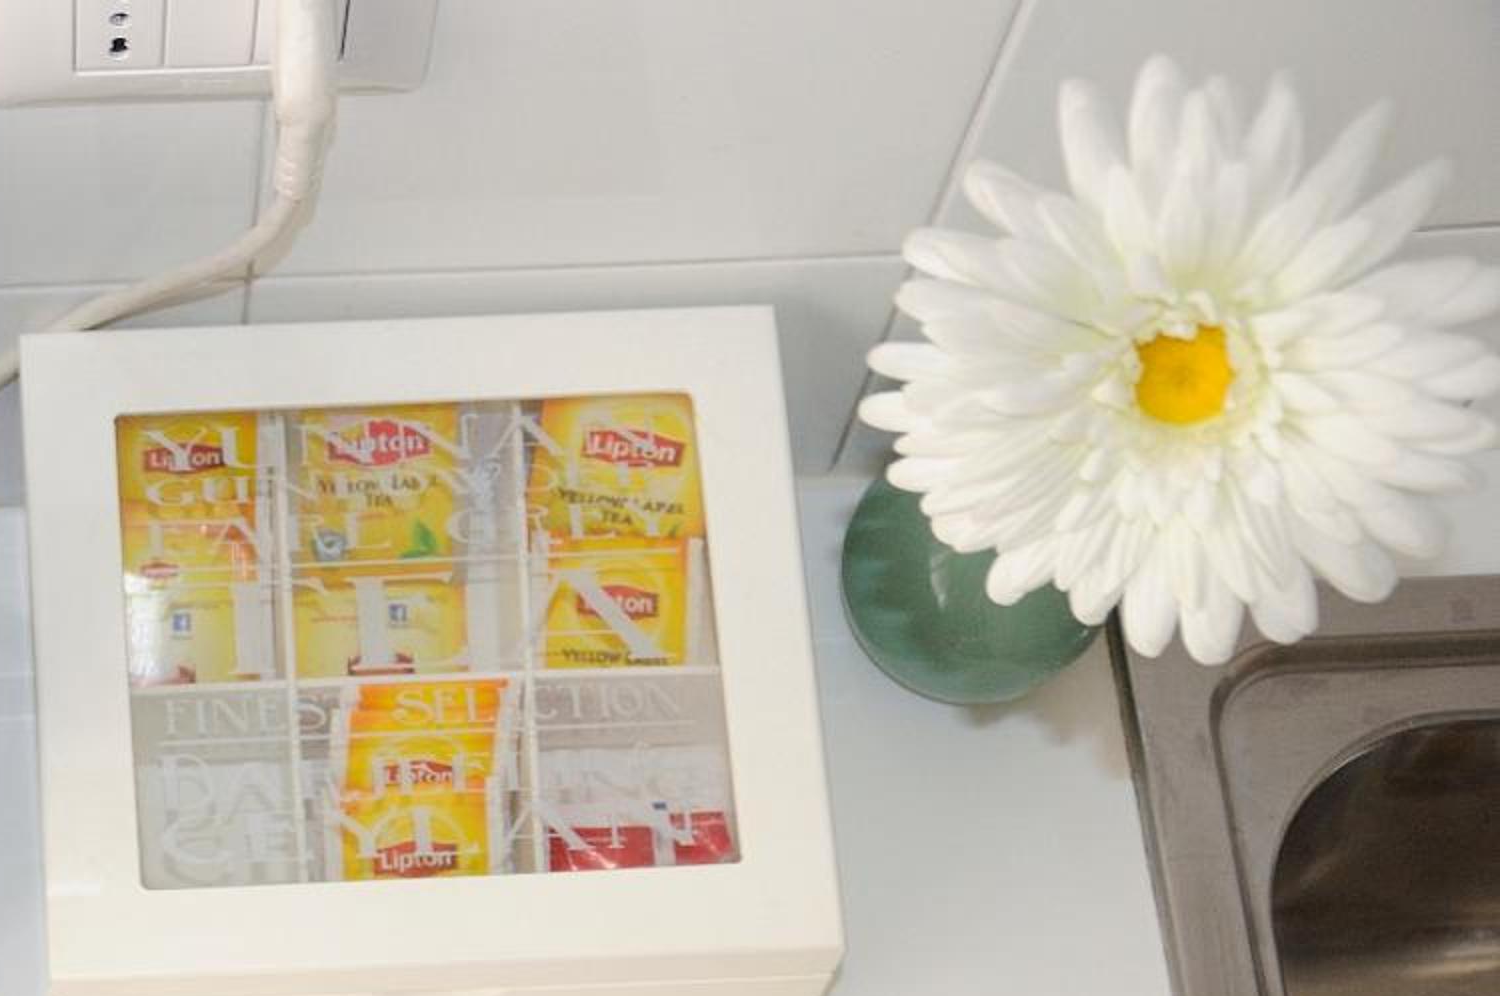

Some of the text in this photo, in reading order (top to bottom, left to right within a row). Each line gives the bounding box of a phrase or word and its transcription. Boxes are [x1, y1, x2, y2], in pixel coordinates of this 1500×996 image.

[150, 449, 221, 472] Lion
[634, 496, 684, 514] ABEL
[379, 849, 453, 872] Lipton
